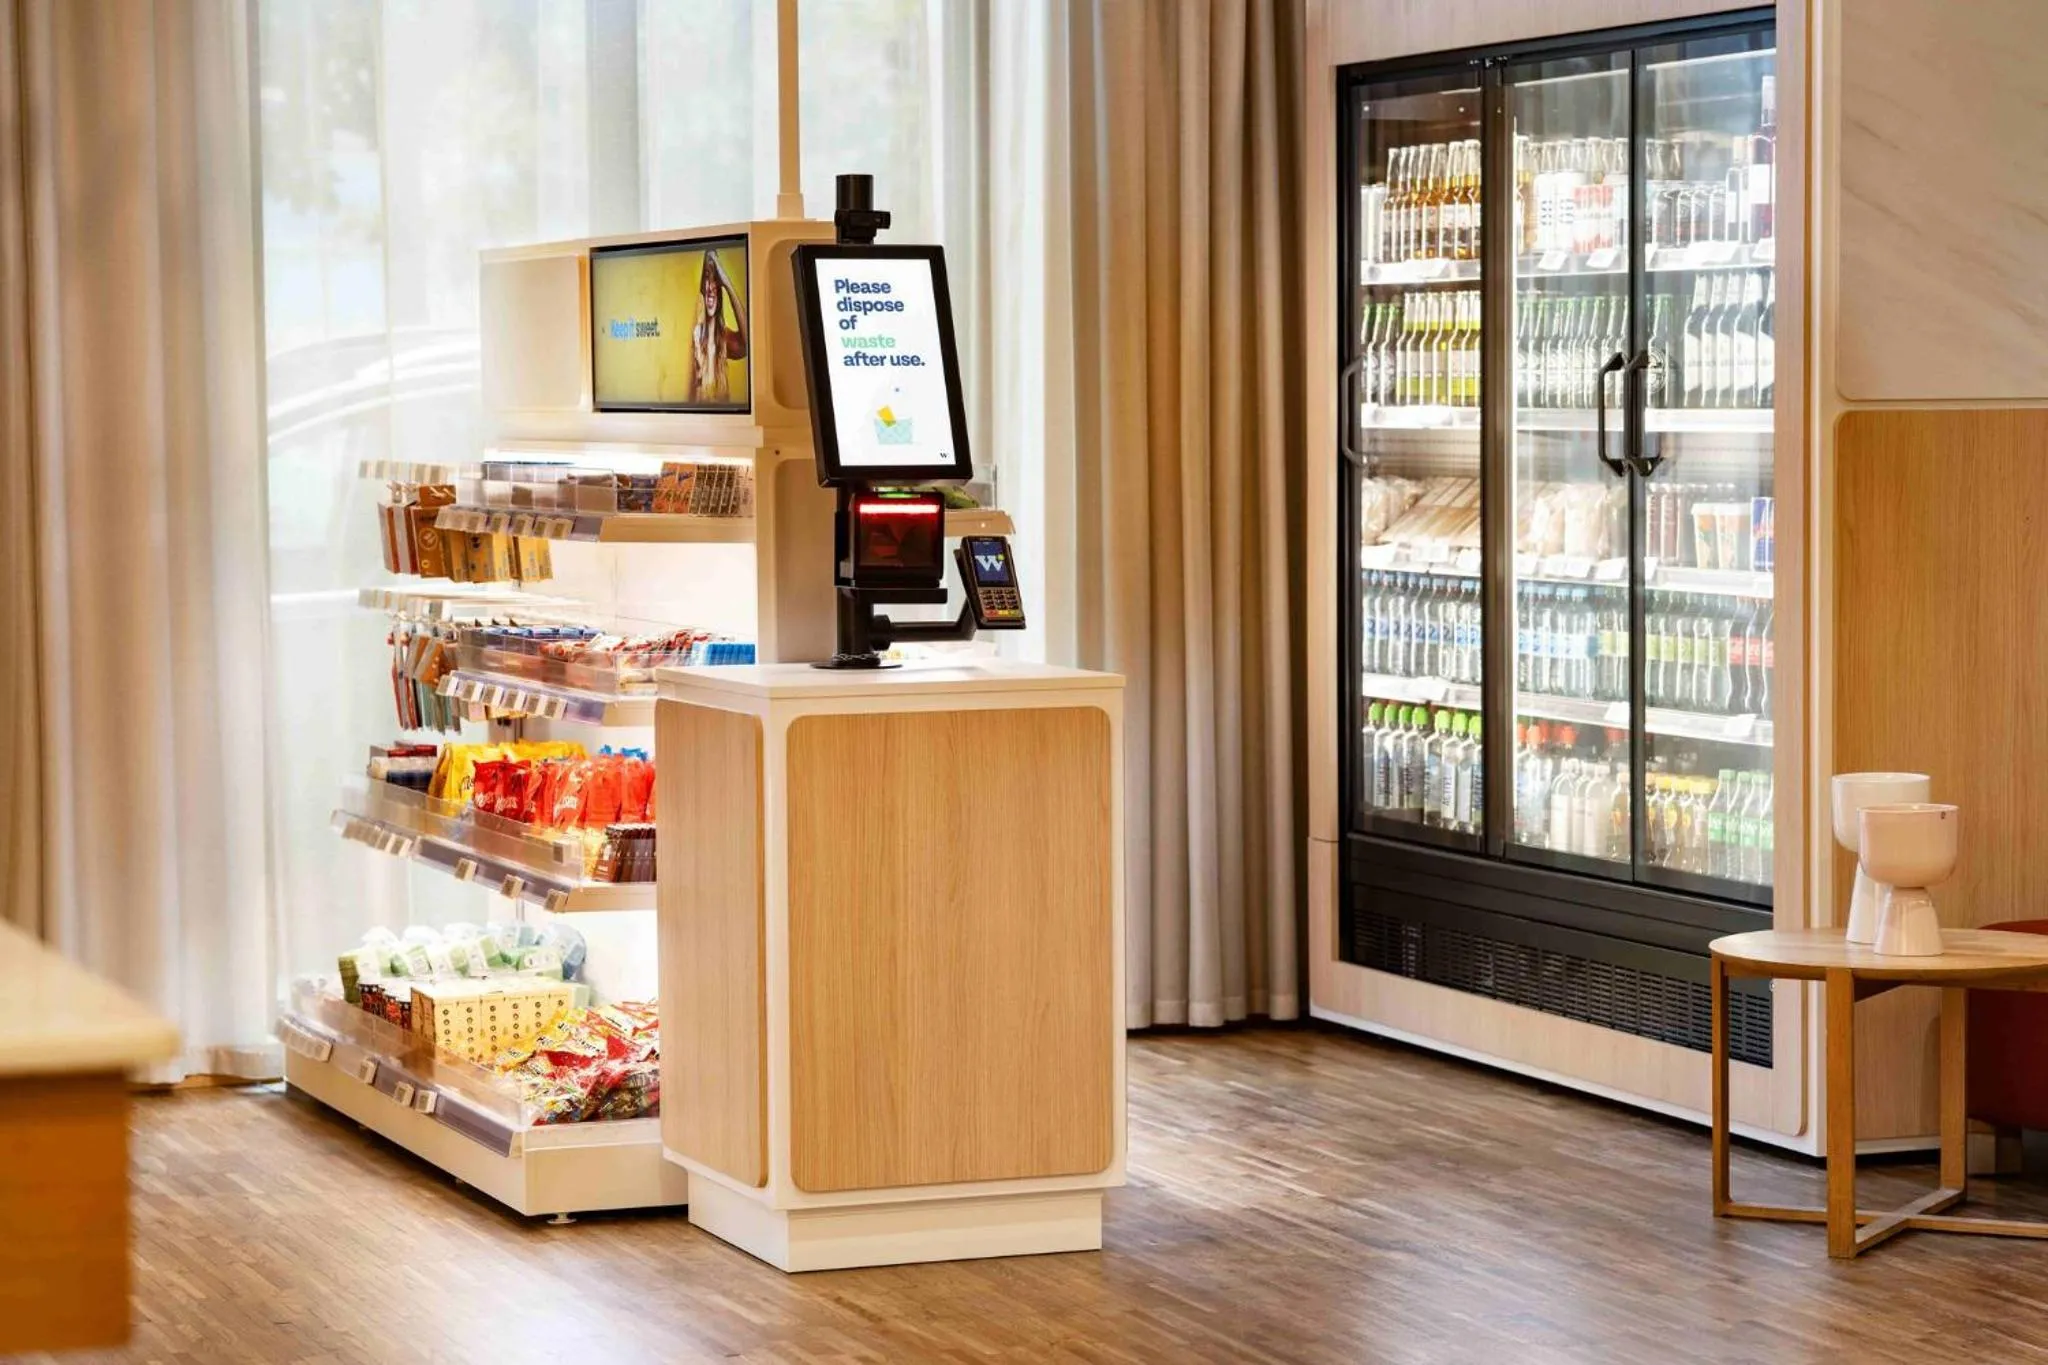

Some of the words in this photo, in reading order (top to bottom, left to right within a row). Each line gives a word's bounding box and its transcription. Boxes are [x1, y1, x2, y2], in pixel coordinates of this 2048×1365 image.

[834, 278, 891, 294] Please
[837, 296, 904, 316] dispose
[839, 315, 857, 330] of
[841, 334, 896, 349] waste
[844, 350, 887, 367] after
[890, 355, 926, 367] use.
[974, 555, 1003, 571] W
